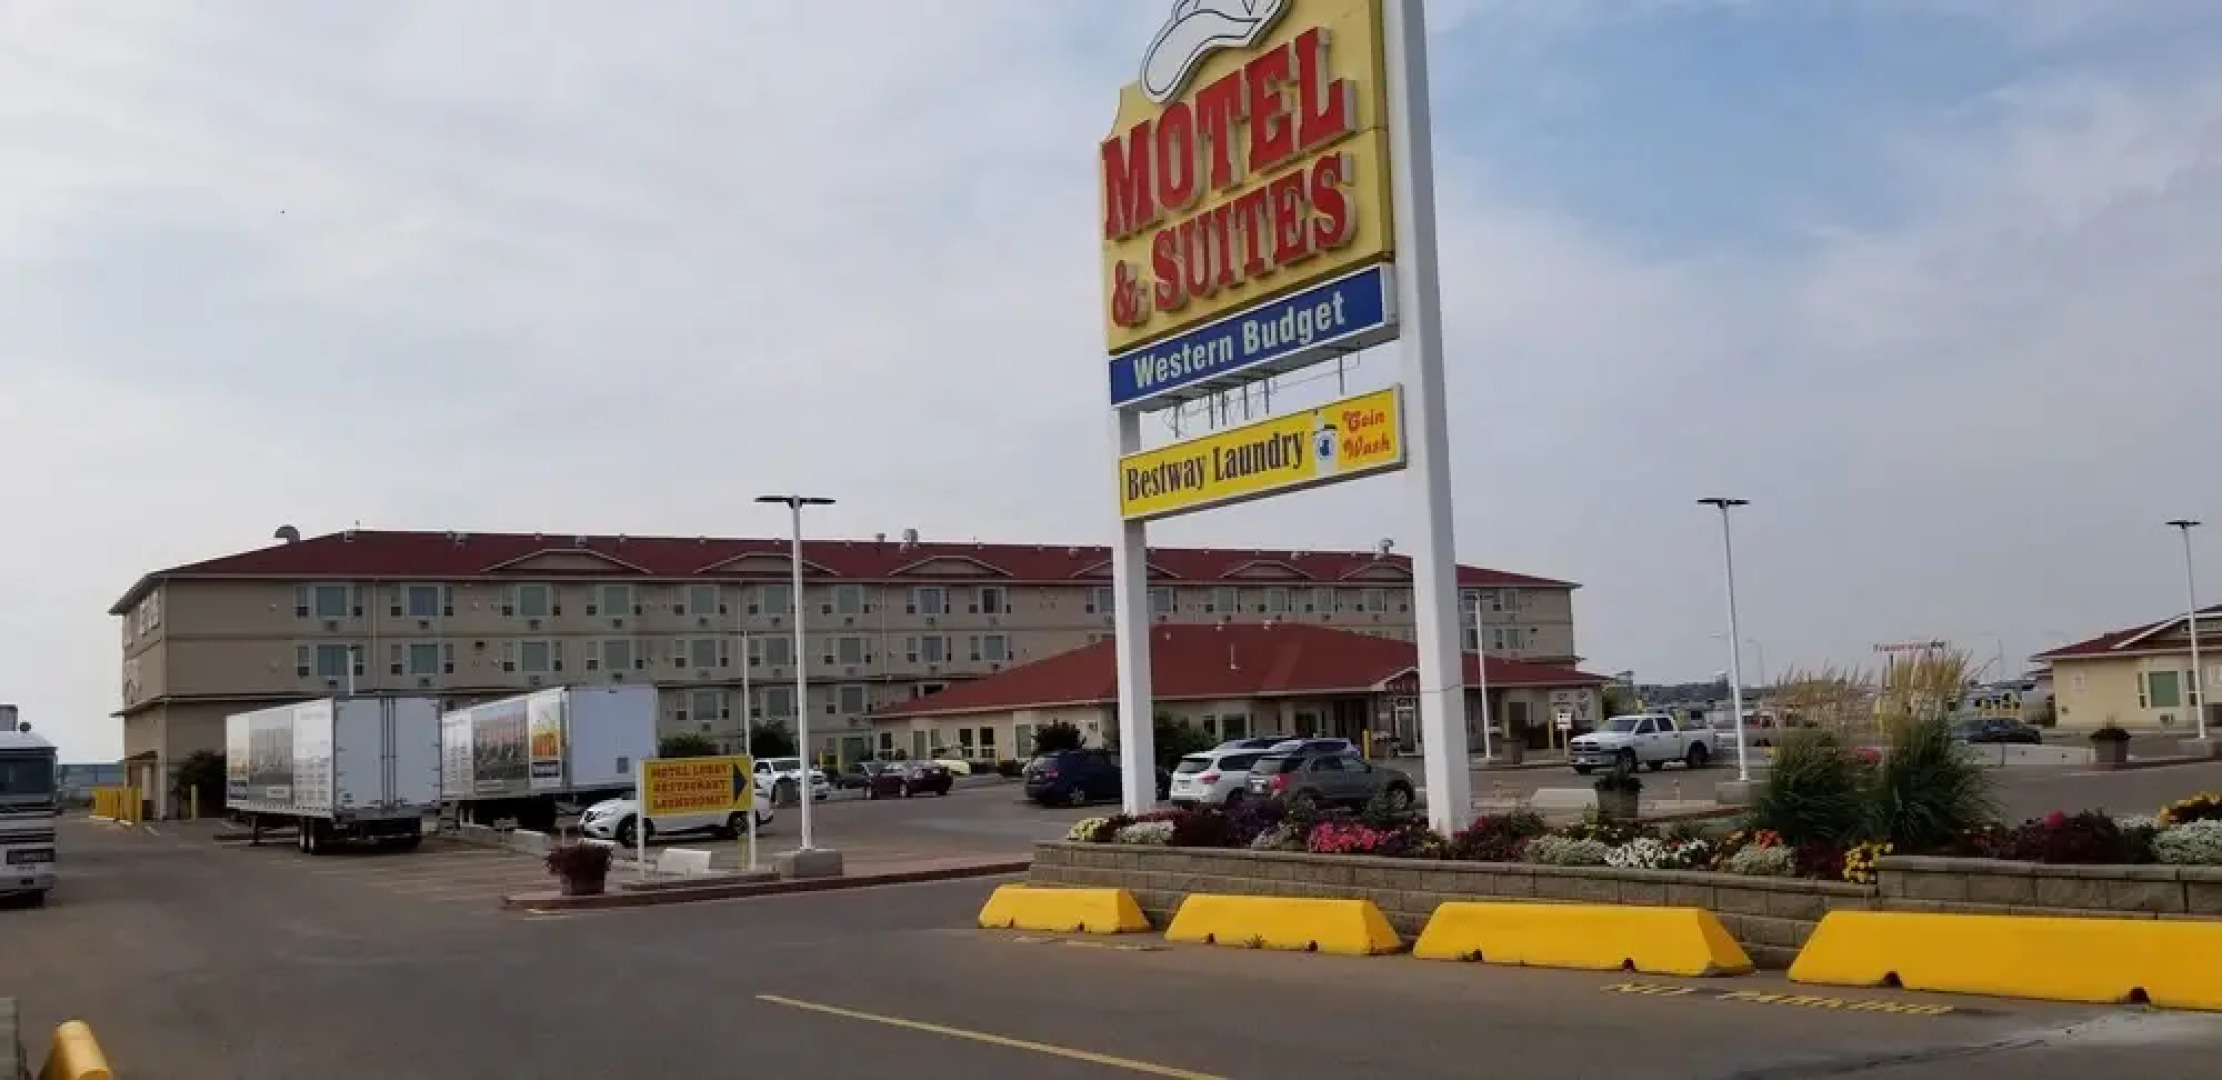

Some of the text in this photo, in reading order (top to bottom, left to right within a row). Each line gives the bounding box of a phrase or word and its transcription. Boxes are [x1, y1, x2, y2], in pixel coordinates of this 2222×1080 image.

[1102, 27, 1352, 240] MOTEL
[1112, 153, 1353, 327] & SUITES
[1134, 291, 1346, 389] Western Budget
[1342, 408, 1385, 432] Coin
[1342, 432, 1389, 459] Wash
[1126, 430, 1305, 501] Bestway Laundry
